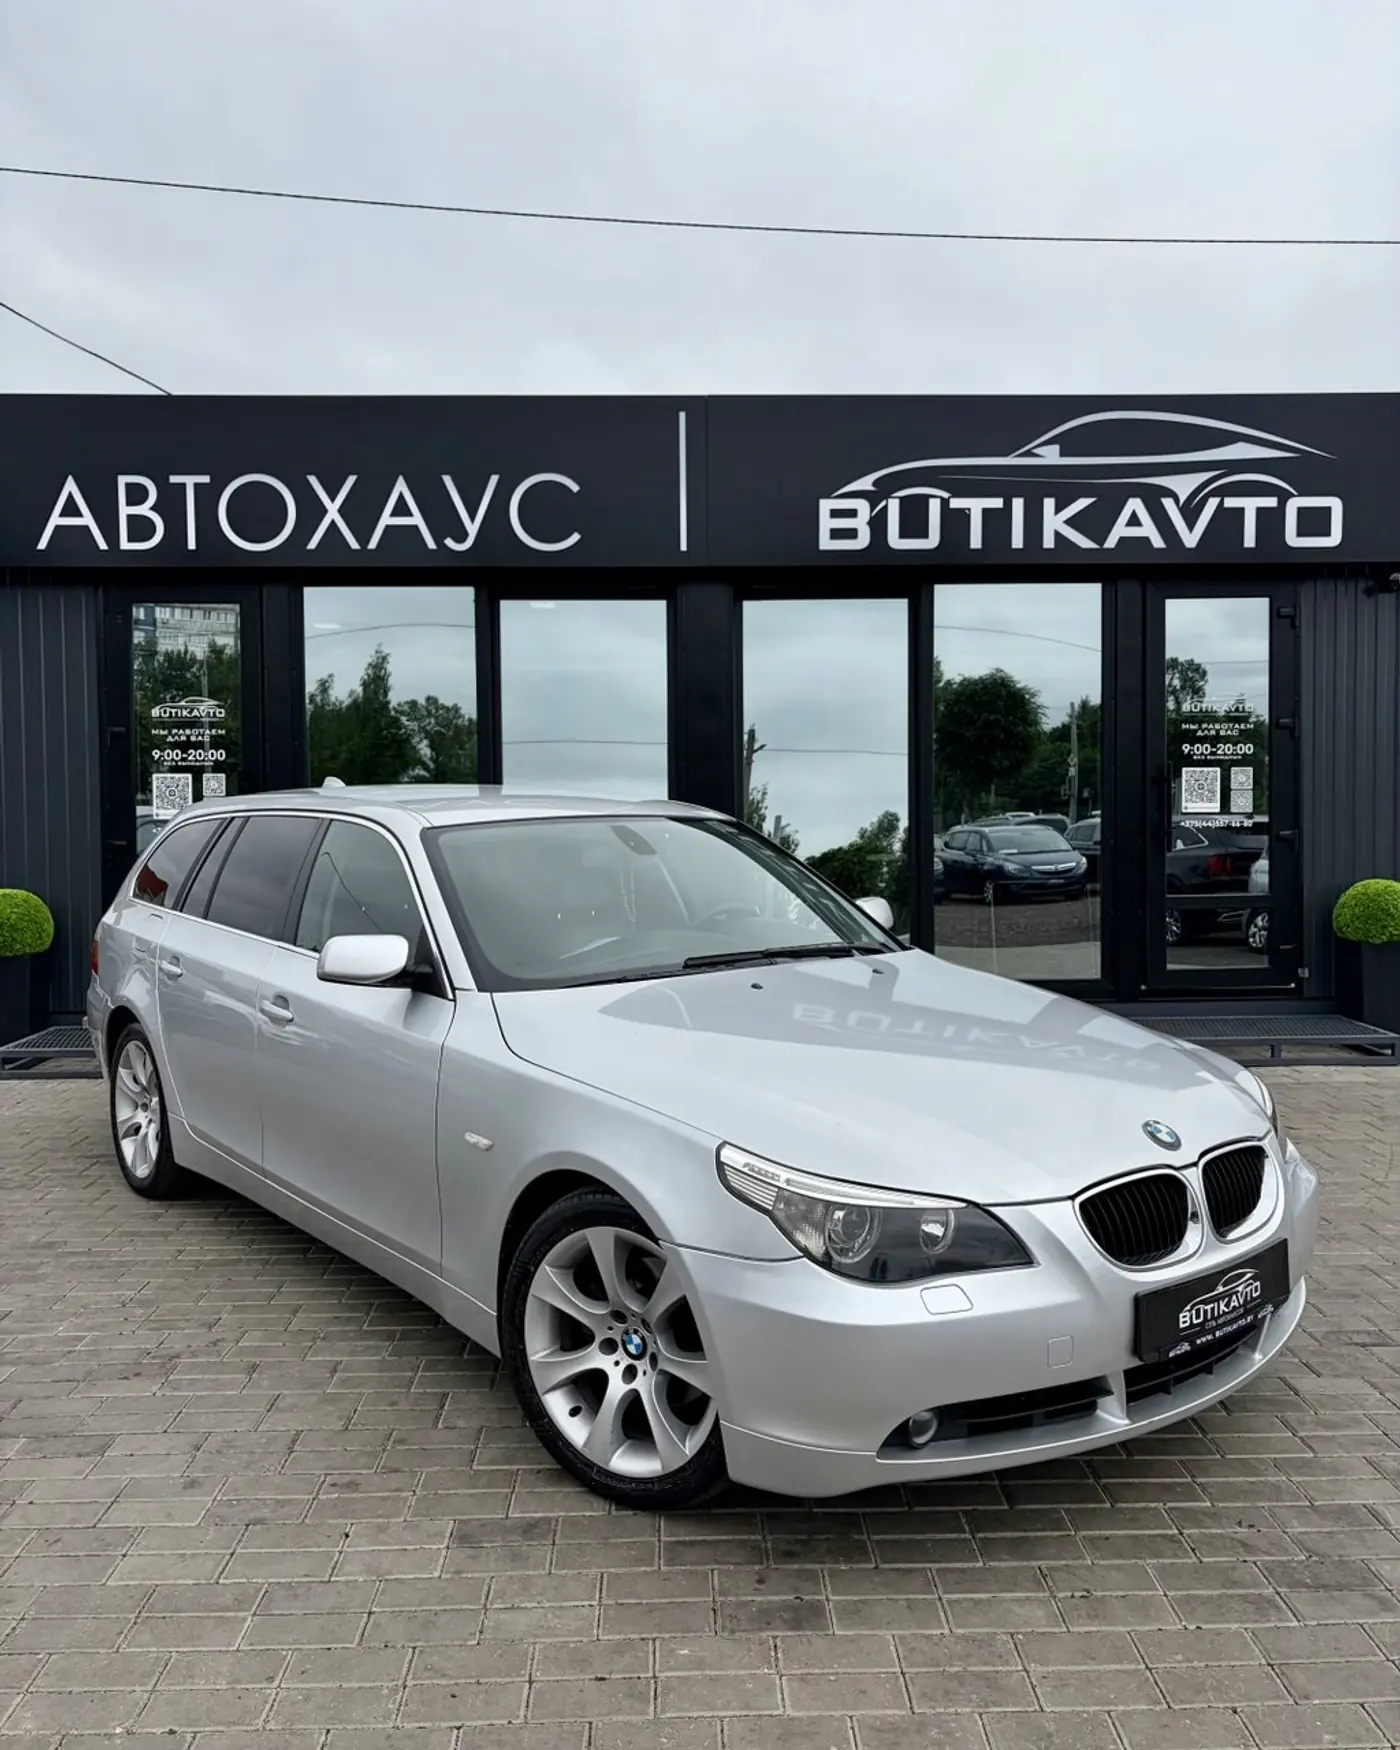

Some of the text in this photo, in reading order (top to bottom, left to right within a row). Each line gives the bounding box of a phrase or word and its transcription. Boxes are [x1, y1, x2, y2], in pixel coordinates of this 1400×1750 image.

[36, 473, 582, 552] АВТОХАУС
[818, 496, 1343, 550] BUTIKAVTO
[151, 707, 226, 718] BUTIKAVTO
[1181, 702, 1254, 713] BUTIKAVTO
[151, 728, 226, 736] МЫ РАБОТАЕМ
[151, 749, 226, 761] 9:00-20:00
[1181, 743, 1254, 755] 9:00-20:00
[1178, 1281, 1261, 1329] BUTIKAVTO
